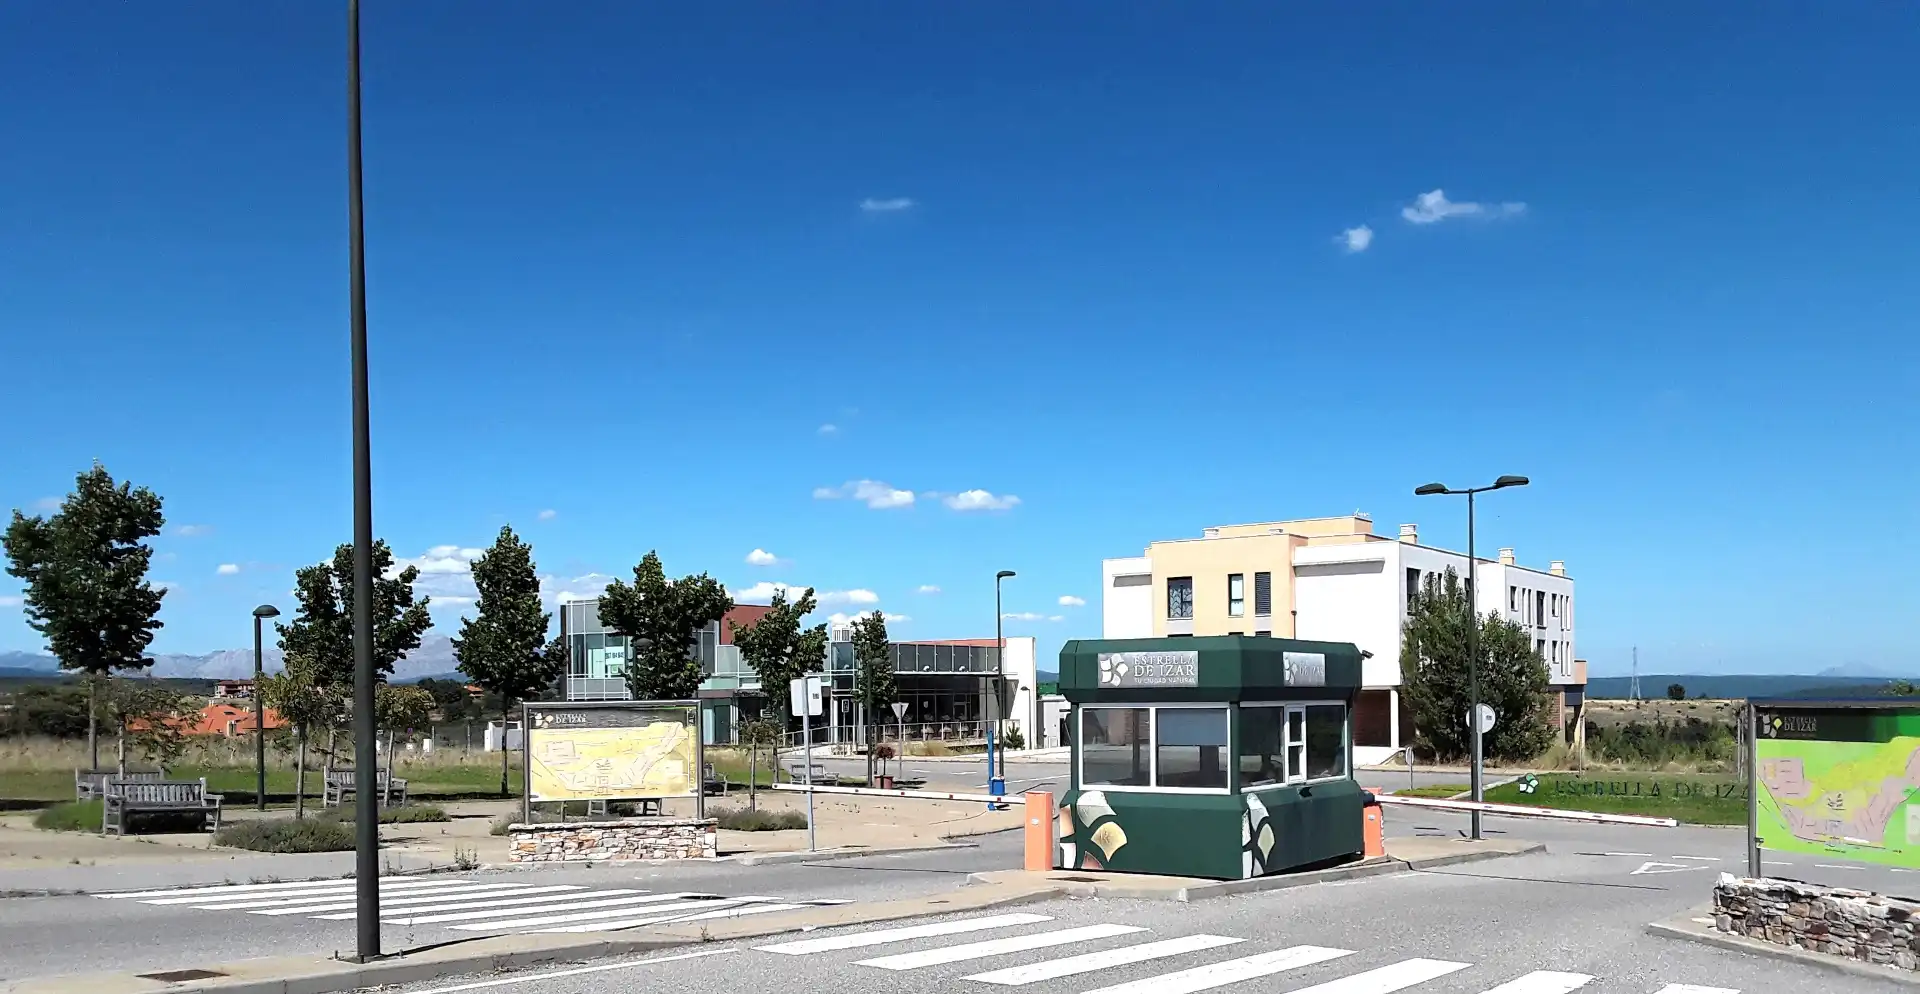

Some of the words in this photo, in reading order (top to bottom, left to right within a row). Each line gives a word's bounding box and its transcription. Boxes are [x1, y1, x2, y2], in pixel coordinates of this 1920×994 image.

[1134, 655, 1195, 665] ESTRELLA
[1133, 664, 1154, 677] DE
[1159, 664, 1195, 676] IZAR
[1784, 723, 1796, 731] DE
[1797, 723, 1817, 732] IZAR
[1555, 780, 1661, 797] ESTRELLA
